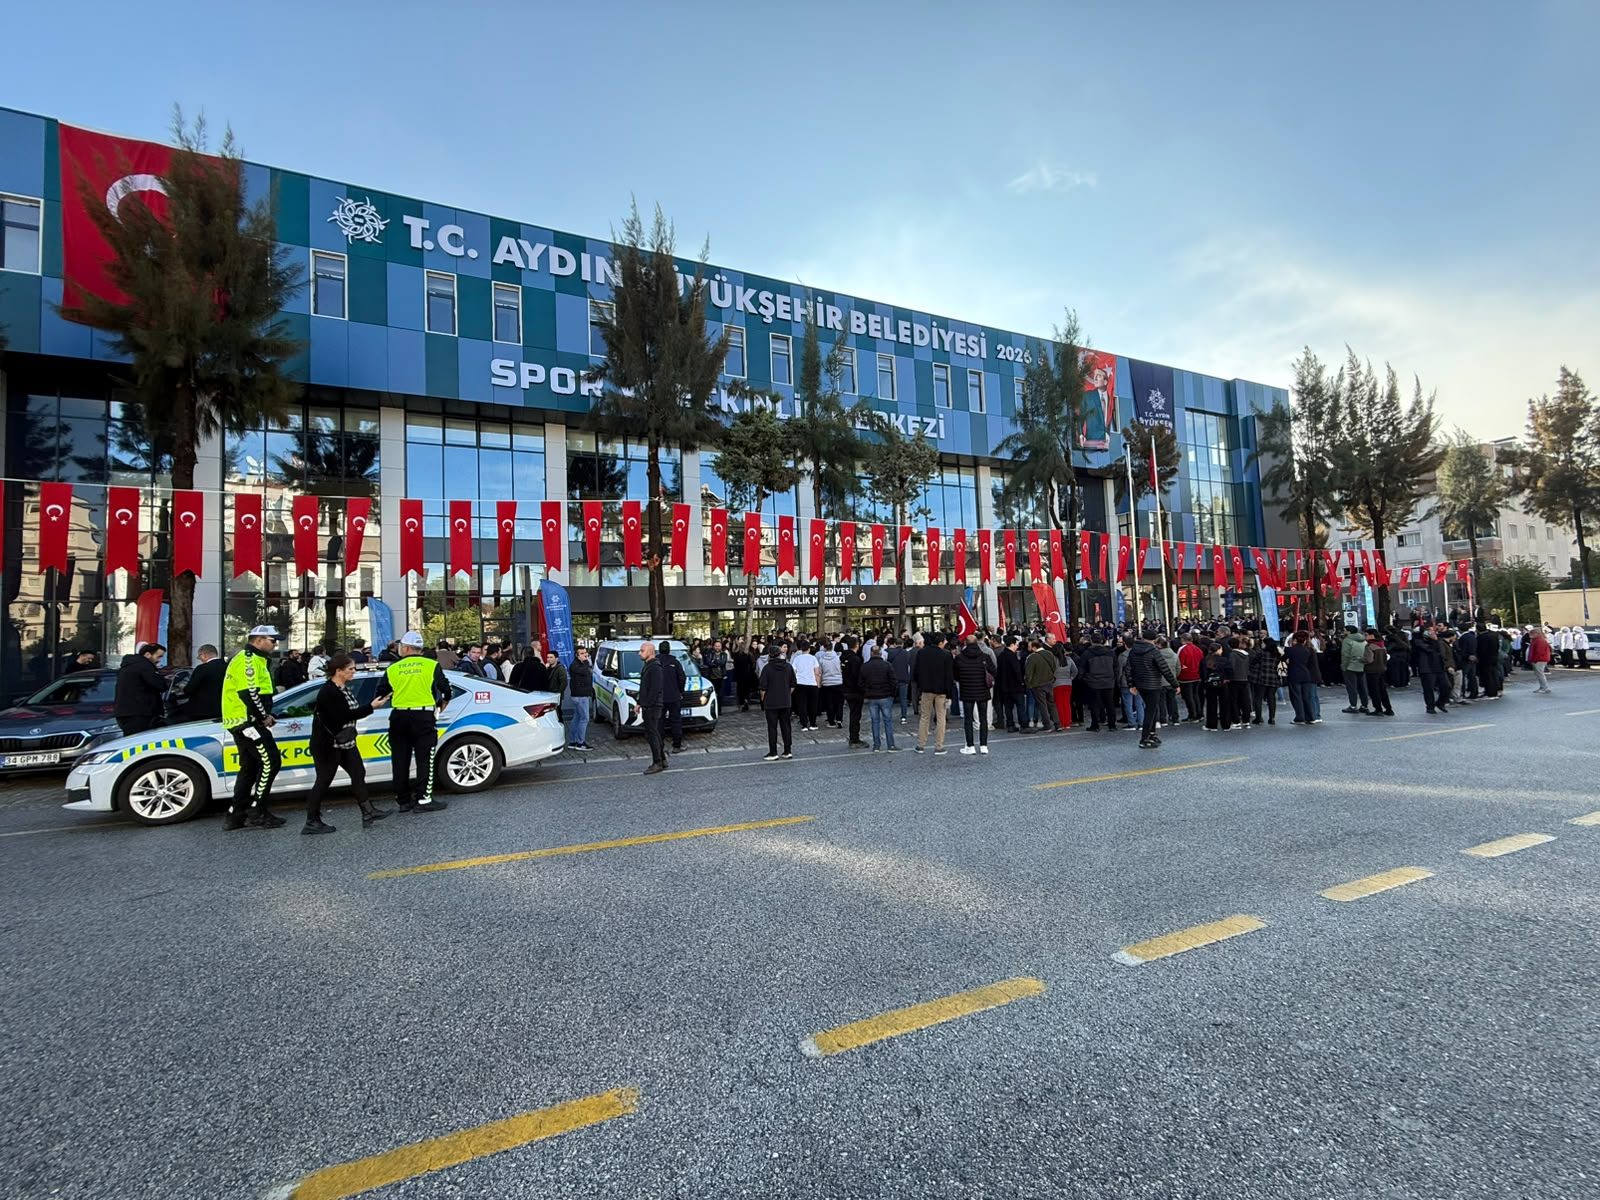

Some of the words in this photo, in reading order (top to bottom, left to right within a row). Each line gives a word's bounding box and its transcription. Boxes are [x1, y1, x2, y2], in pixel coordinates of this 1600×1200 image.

[403, 215, 478, 259] T.C.
[493, 236, 624, 288] AYDIN
[637, 262, 843, 331] YÜKŞEHİR
[850, 309, 987, 359] BELEDİYESİ
[830, 405, 945, 439] ERKEZİ
[728, 588, 750, 596] AYDI
[756, 586, 807, 597] BÜYÜKŞEHİR
[809, 586, 853, 596] BEEDİYESİ
[737, 597, 760, 605] SPR
[762, 597, 772, 605] VE
[773, 595, 811, 605] ETKİNLİK
[812, 595, 846, 604] MRKEZİ
[476, 692, 489, 700] 112
